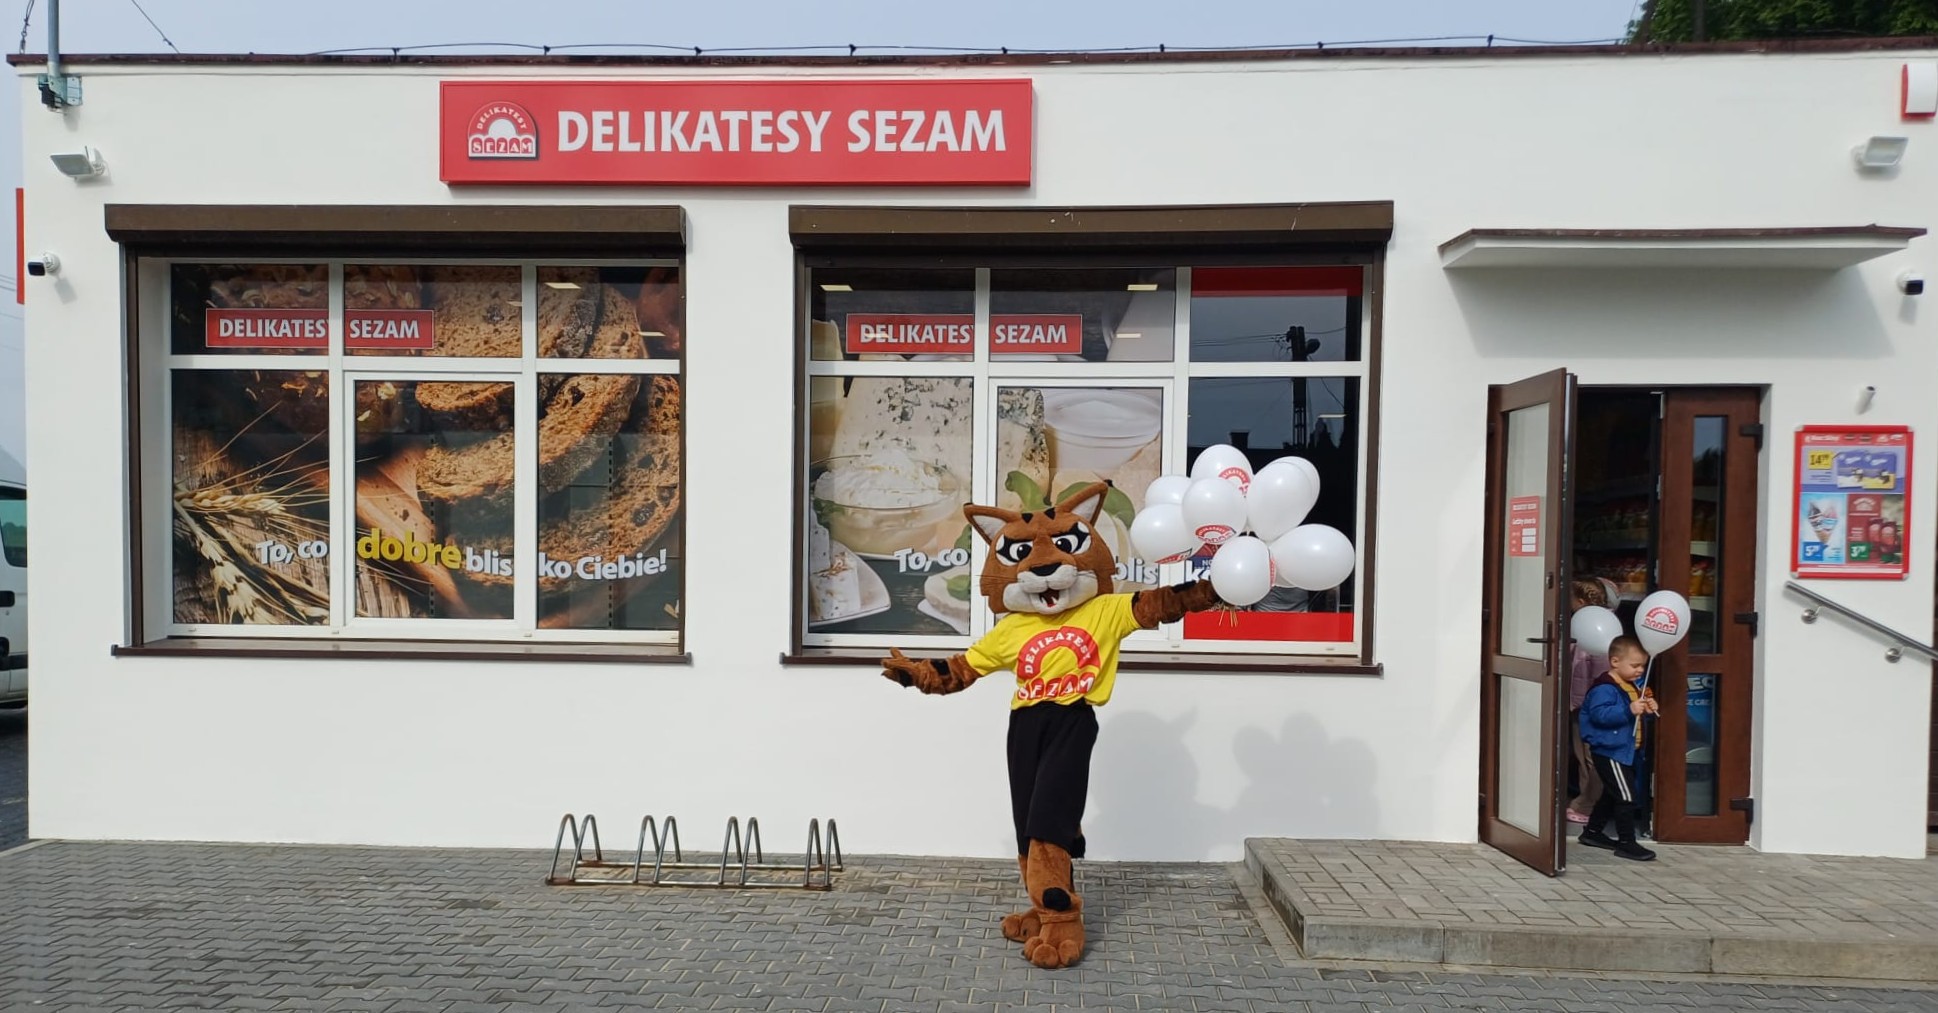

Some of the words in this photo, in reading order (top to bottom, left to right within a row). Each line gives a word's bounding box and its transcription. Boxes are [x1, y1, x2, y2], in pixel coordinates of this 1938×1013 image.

[476, 106, 527, 130] DELIKATESY
[557, 110, 832, 153] DELIKATESY
[847, 109, 1006, 153] SEZAM
[472, 142, 533, 153] SEZAM
[219, 318, 329, 338] DELIKATES
[349, 319, 420, 339] SEZAM
[860, 323, 974, 344] DELIKATES
[994, 324, 1067, 344] SEZAM
[255, 540, 294, 564] To,
[298, 540, 328, 558] co
[357, 527, 463, 570] dobre
[575, 548, 667, 580] Ciebie!
[894, 547, 932, 573] To,
[938, 548, 968, 566] co
[1024, 632, 1091, 674] DELIKATESY
